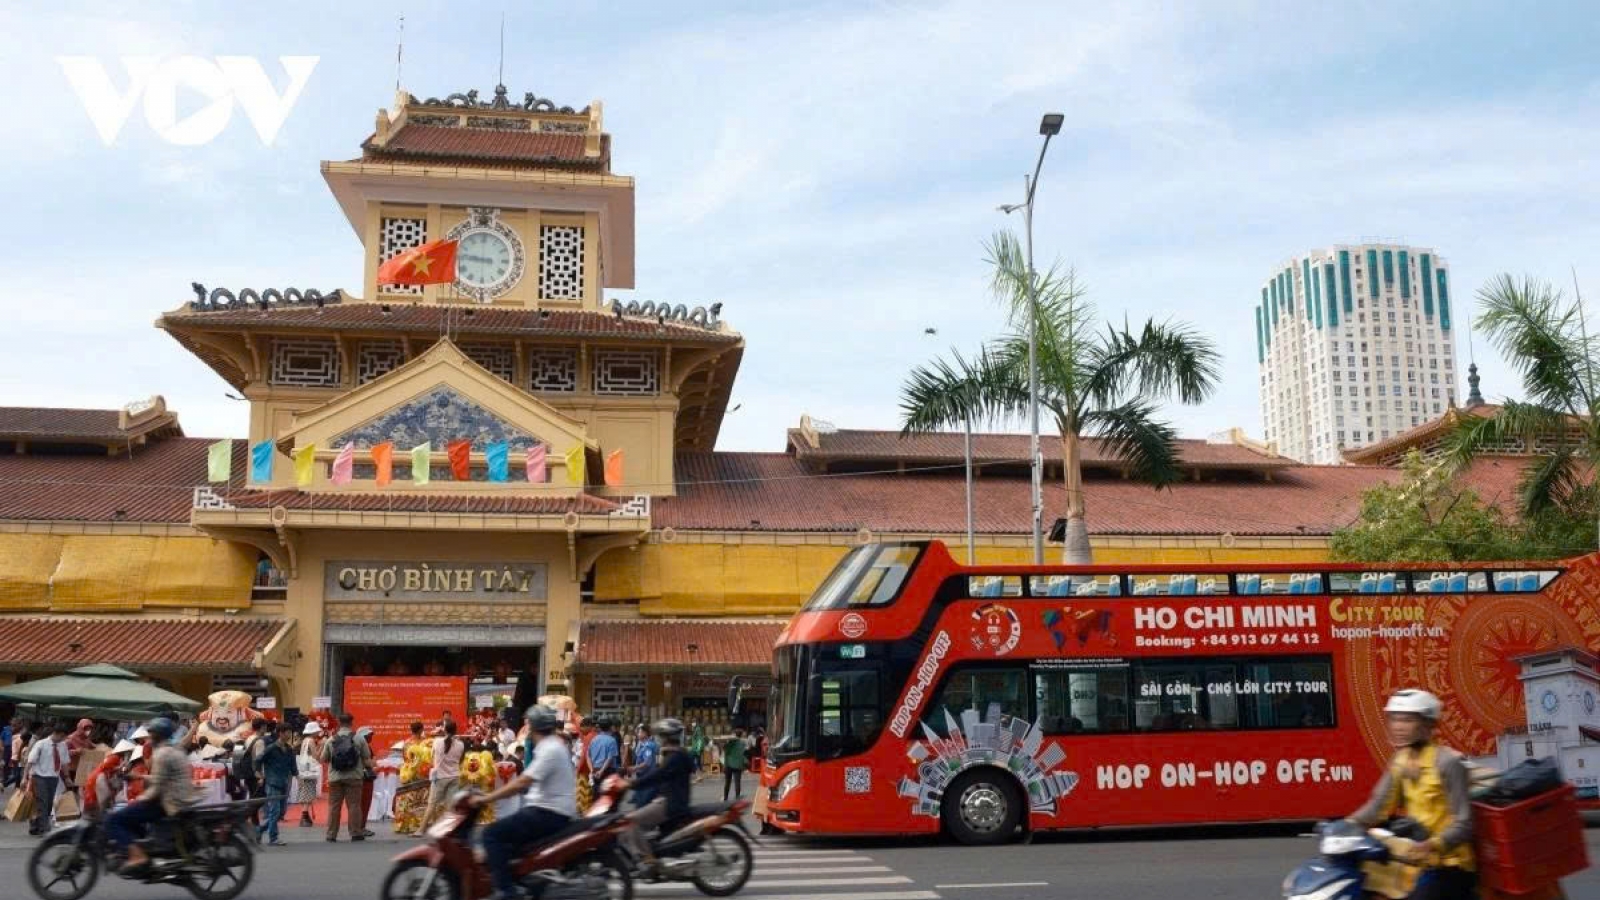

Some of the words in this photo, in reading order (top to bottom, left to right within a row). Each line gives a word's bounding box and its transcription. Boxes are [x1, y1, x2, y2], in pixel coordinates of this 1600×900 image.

[339, 565, 397, 596] CHỢ
[404, 563, 474, 591] BÌNH
[1134, 606, 1177, 629] HO
[1184, 606, 1235, 629] CHI
[1242, 605, 1317, 628] MINH
[1135, 634, 1196, 649] Booking:
[1200, 634, 1227, 645] +84
[1231, 634, 1257, 645] 913
[1260, 634, 1278, 645] 67
[1282, 633, 1299, 644] 44
[1303, 633, 1319, 644] 12
[1331, 623, 1443, 641] hopon-hopoff.vn
[1141, 681, 1161, 696] SÀI
[1207, 681, 1232, 697] CHỢ
[1263, 682, 1291, 694] CITY
[1296, 681, 1328, 693] TOUR
[1097, 764, 1150, 790] HOP
[1277, 758, 1353, 783] OFF.VN
